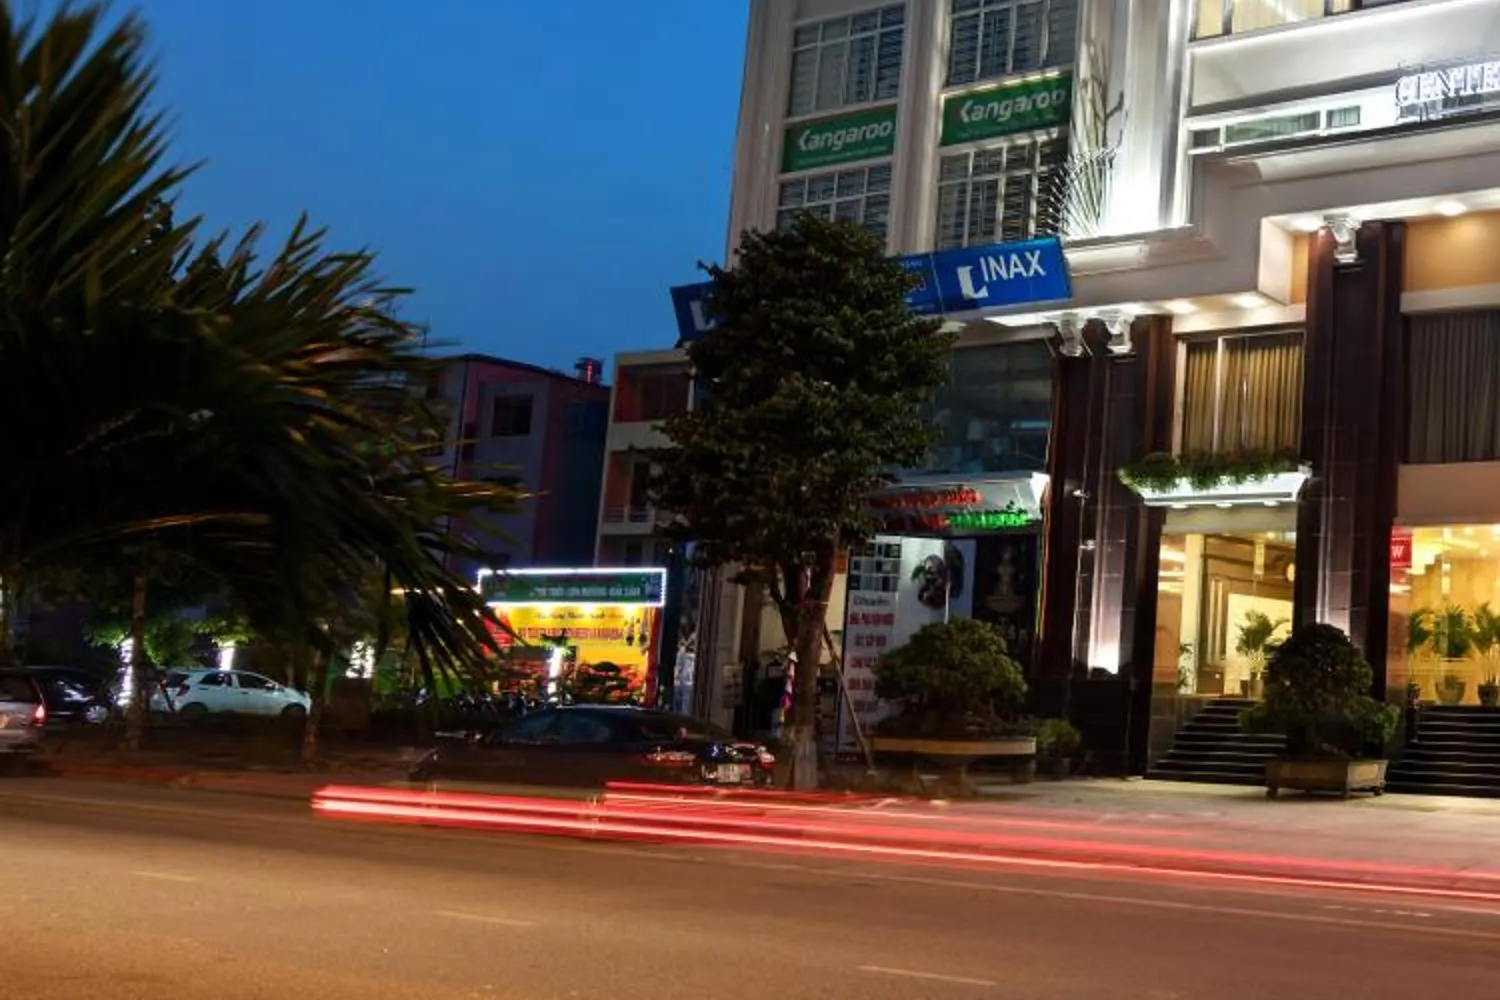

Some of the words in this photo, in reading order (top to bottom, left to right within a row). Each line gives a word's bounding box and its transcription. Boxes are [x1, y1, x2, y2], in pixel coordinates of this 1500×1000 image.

[955, 87, 1067, 123] Kangaroo
[798, 121, 893, 151] Kangaroo
[979, 249, 1046, 282] INAX
